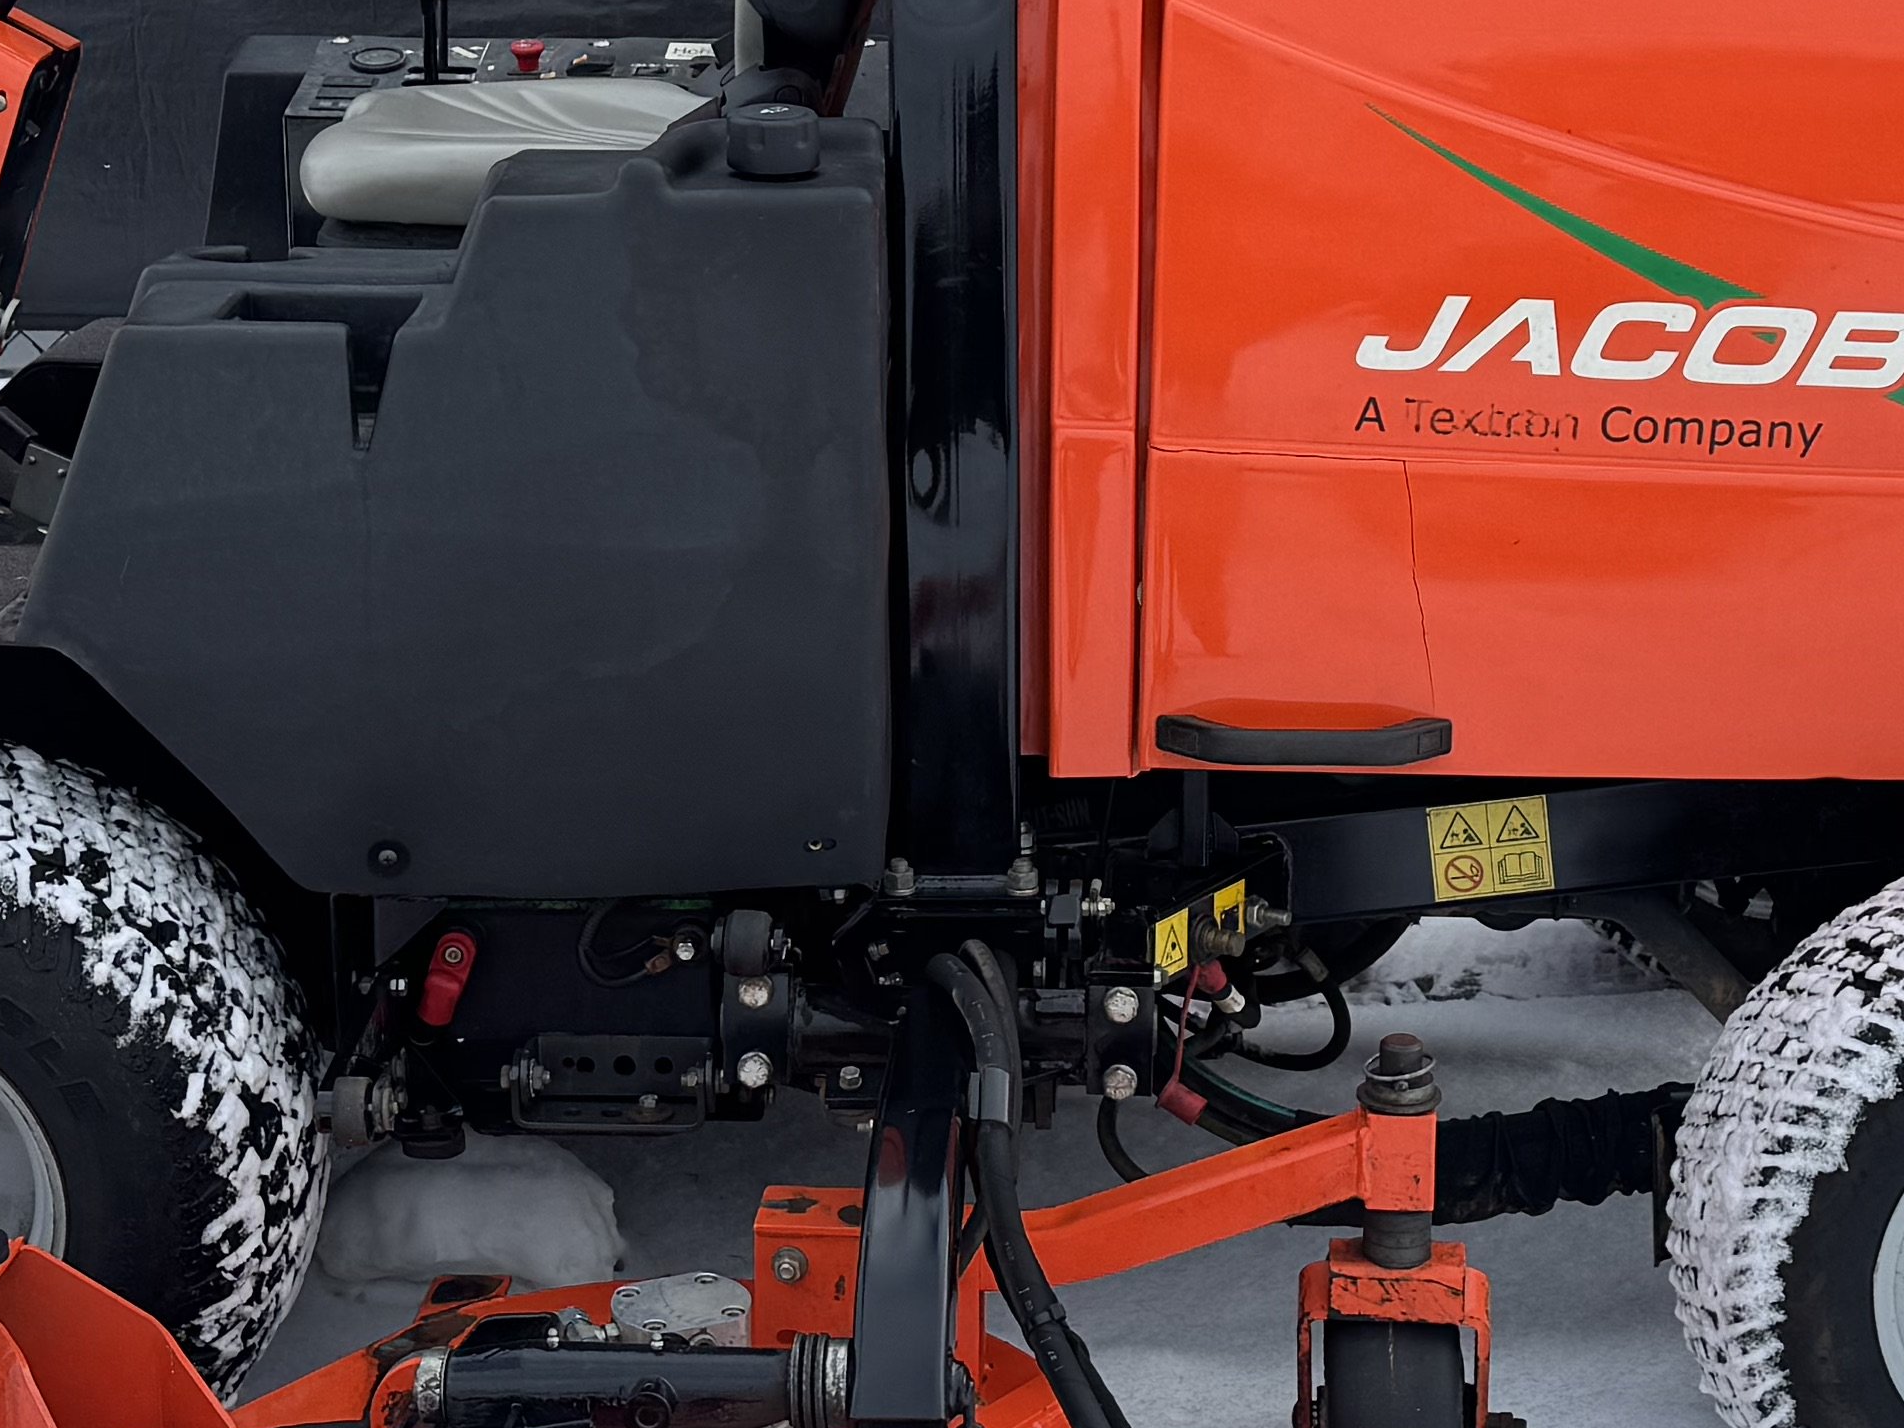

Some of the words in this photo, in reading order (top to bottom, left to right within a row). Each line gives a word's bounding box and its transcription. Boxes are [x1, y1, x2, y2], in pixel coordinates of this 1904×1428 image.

[1354, 396, 1386, 433] A
[1404, 396, 1580, 441] Textron
[1599, 405, 1824, 459] Company
